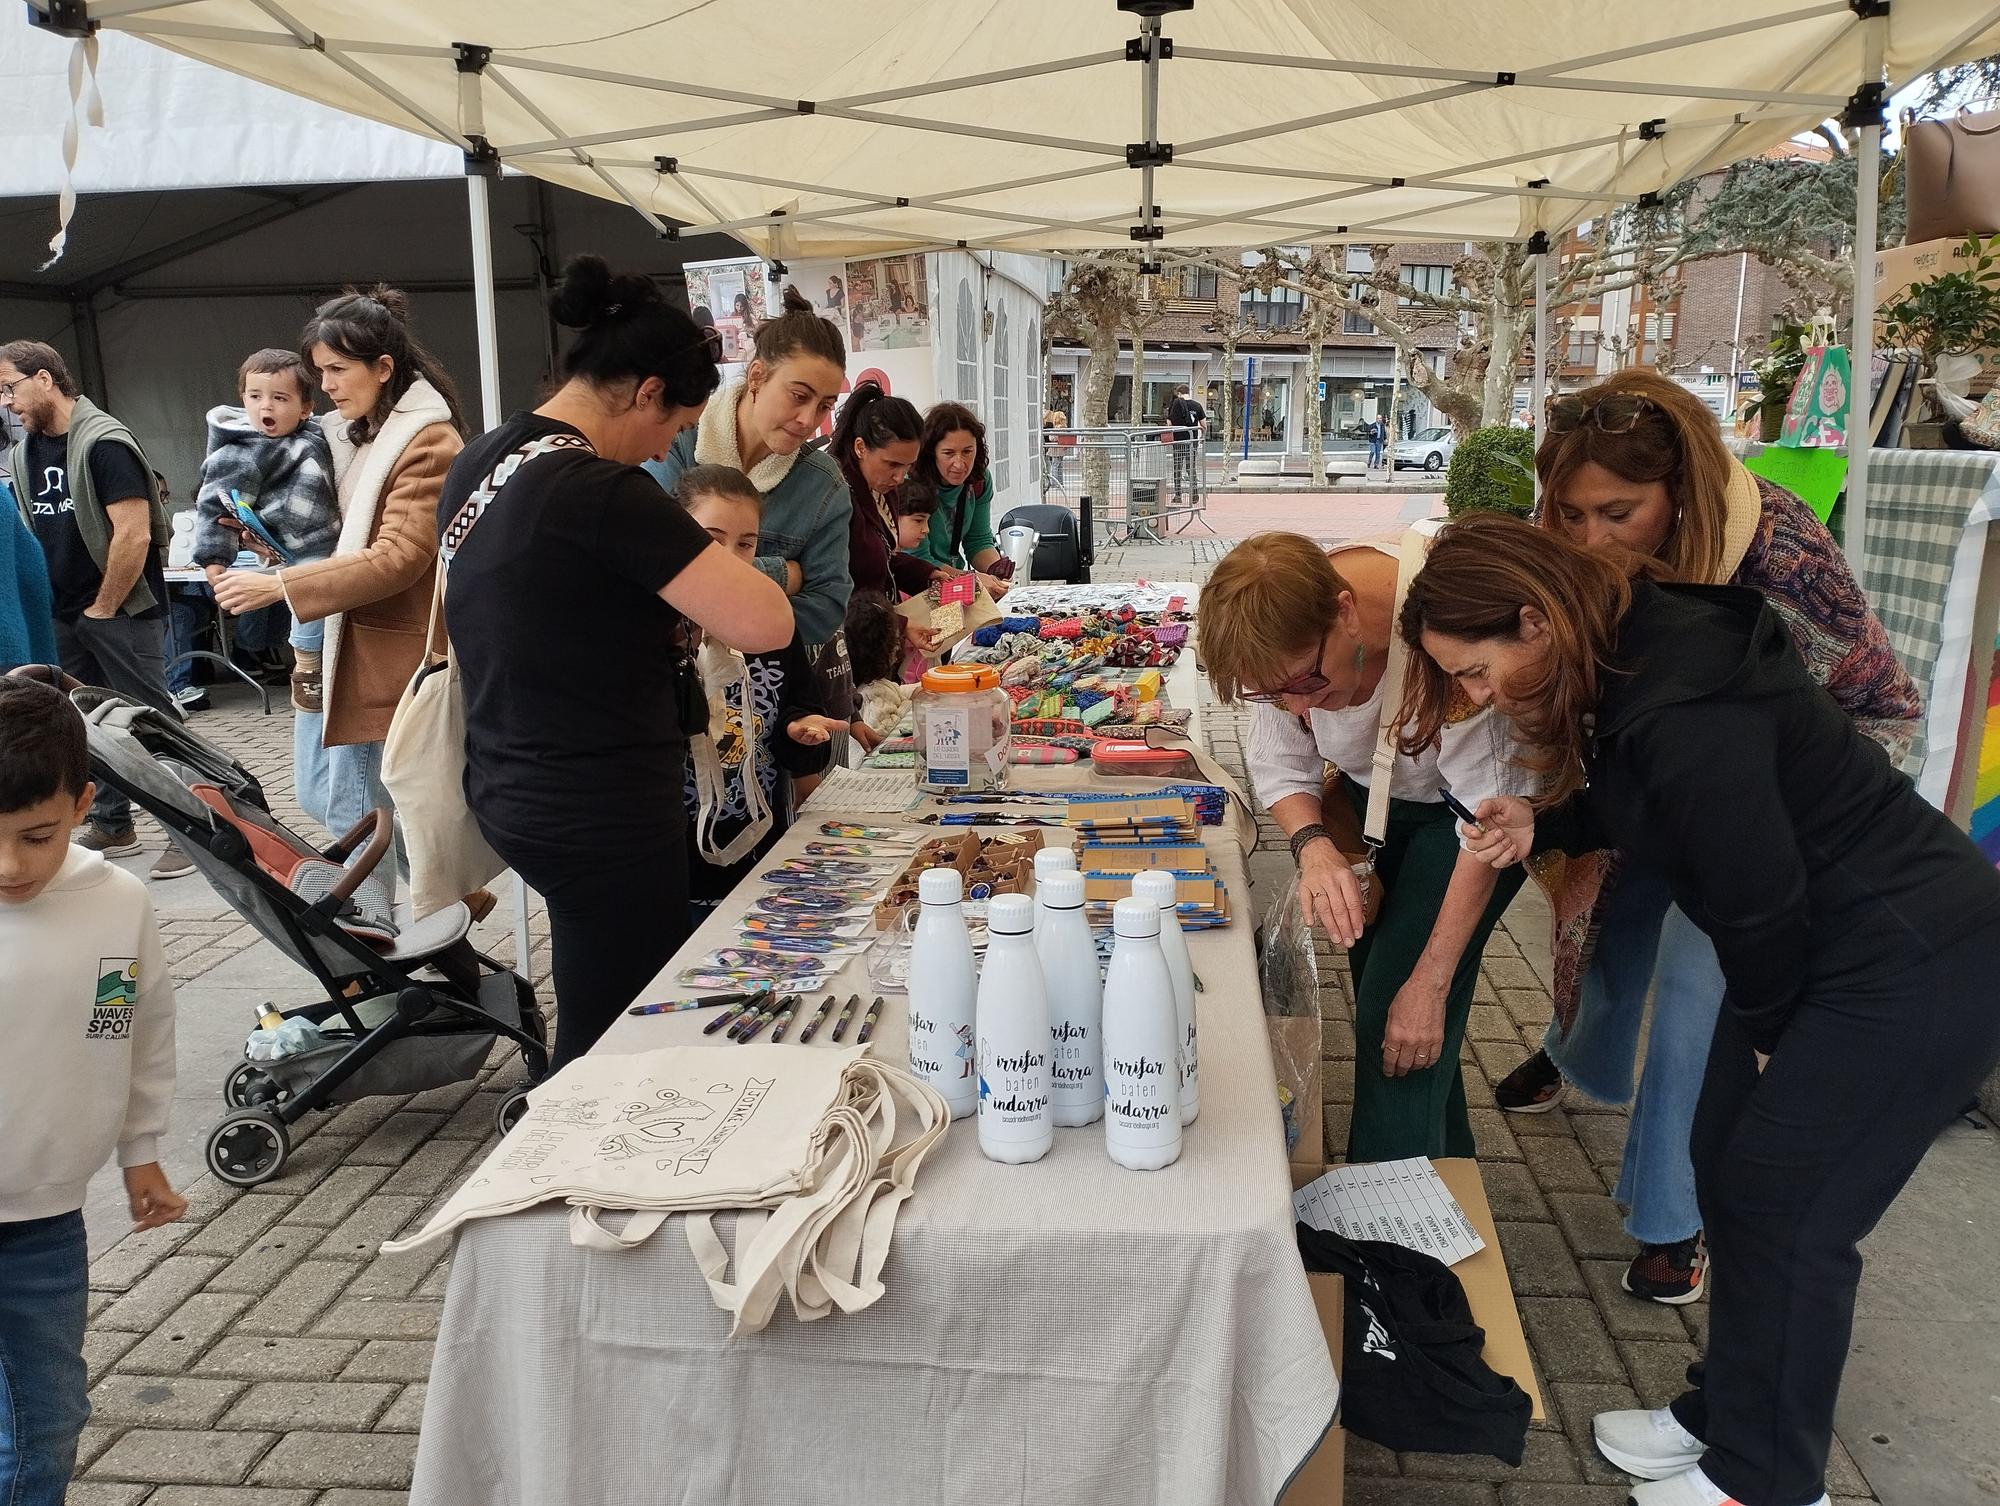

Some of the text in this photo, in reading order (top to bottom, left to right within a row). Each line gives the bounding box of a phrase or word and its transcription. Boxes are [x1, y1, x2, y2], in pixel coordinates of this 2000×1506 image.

[1673, 376, 1697, 385] SORIA
[93, 1007, 134, 1019] WAVES
[88, 1020, 132, 1034] SPOT
[1051, 1020, 1089, 1043] rifar
[996, 1050, 1046, 1074] irrifar
[1054, 1046, 1080, 1059] aten
[1113, 1056, 1166, 1080] irrifar
[1005, 1076, 1039, 1092] baten
[1121, 1081, 1156, 1097] baten
[993, 1094, 1049, 1113] indarra
[1111, 1099, 1171, 1121] indarra
[1333, 1216, 1350, 1240] ORDONES
[1351, 1221, 1366, 1240] ULSERA
[1366, 1221, 1381, 1241] USKERA
